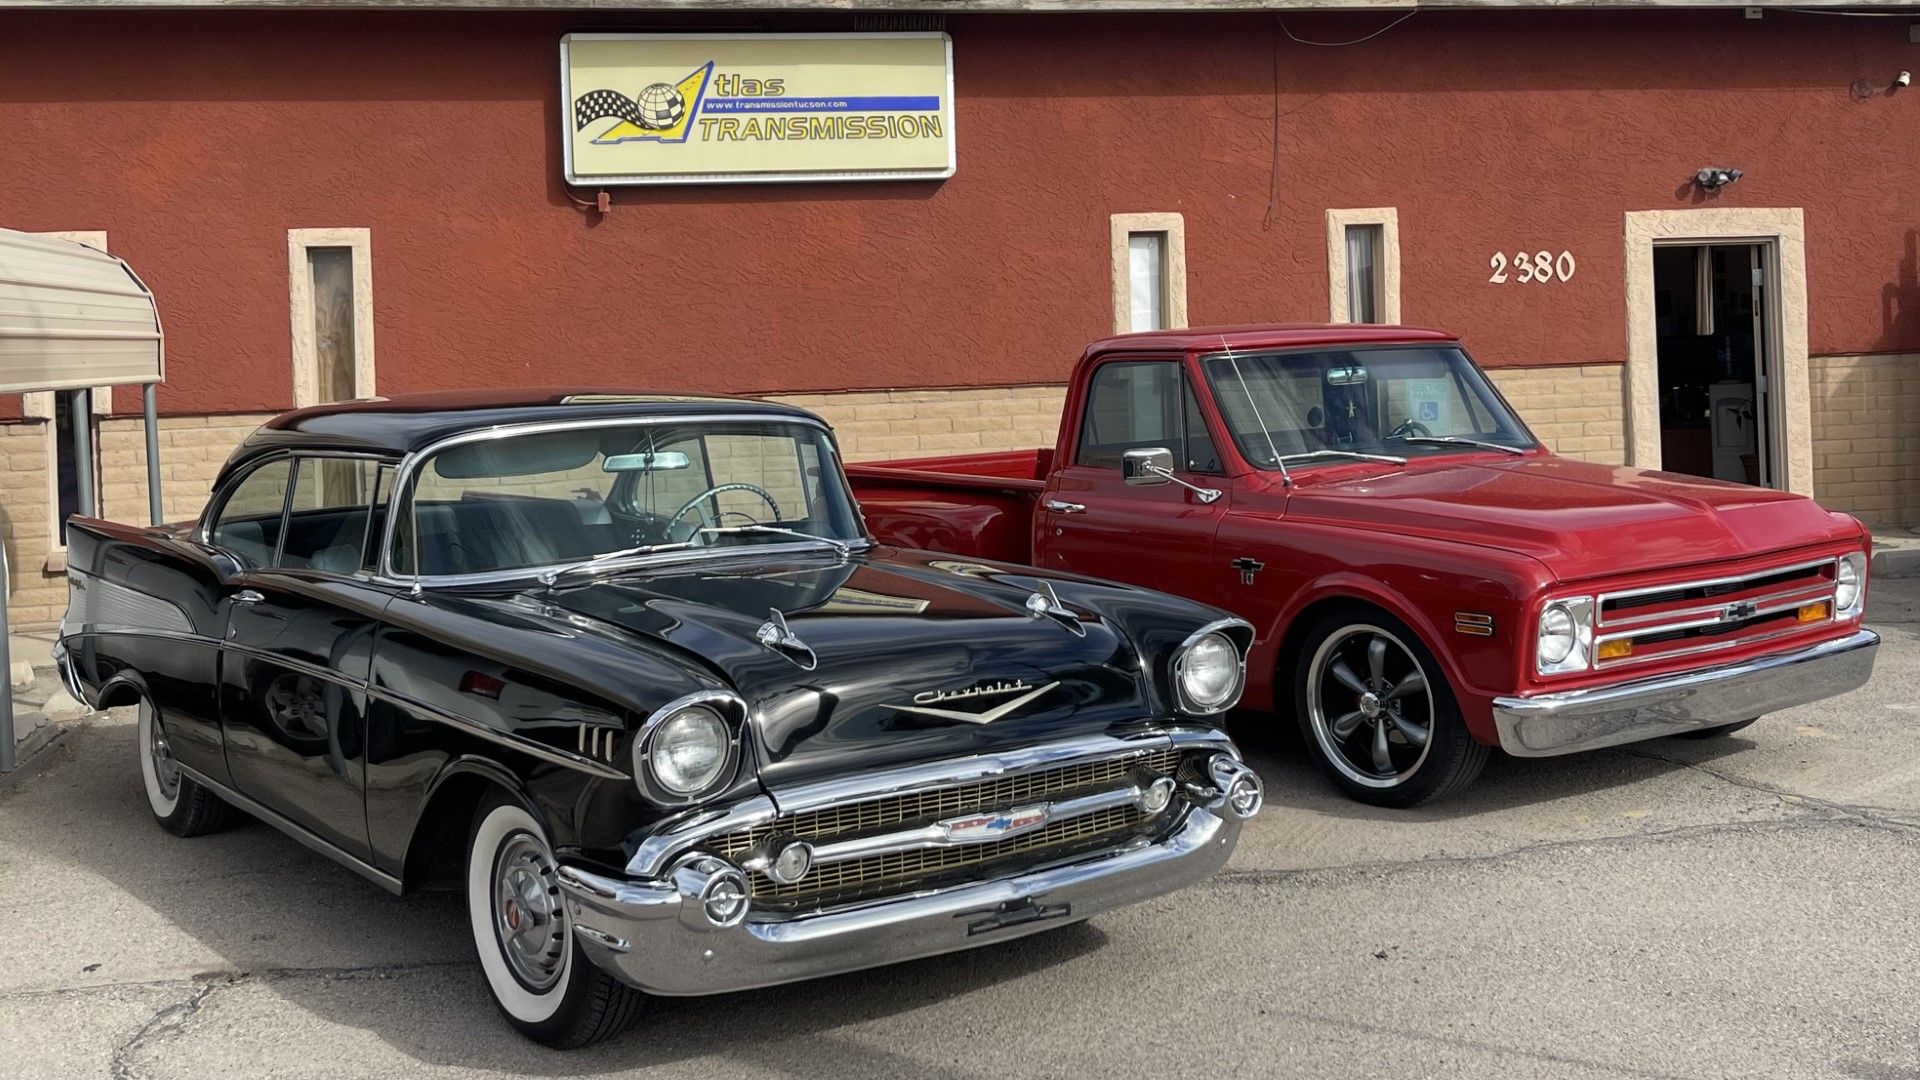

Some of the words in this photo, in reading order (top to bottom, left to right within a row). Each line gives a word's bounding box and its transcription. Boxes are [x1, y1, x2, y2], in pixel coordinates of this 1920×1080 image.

[706, 100, 848, 110] www.transmissiontucson.com
[699, 115, 943, 141] TRANSMISSION
[1488, 250, 1576, 284] 2380
[914, 679, 1033, 704] Chevrolet
